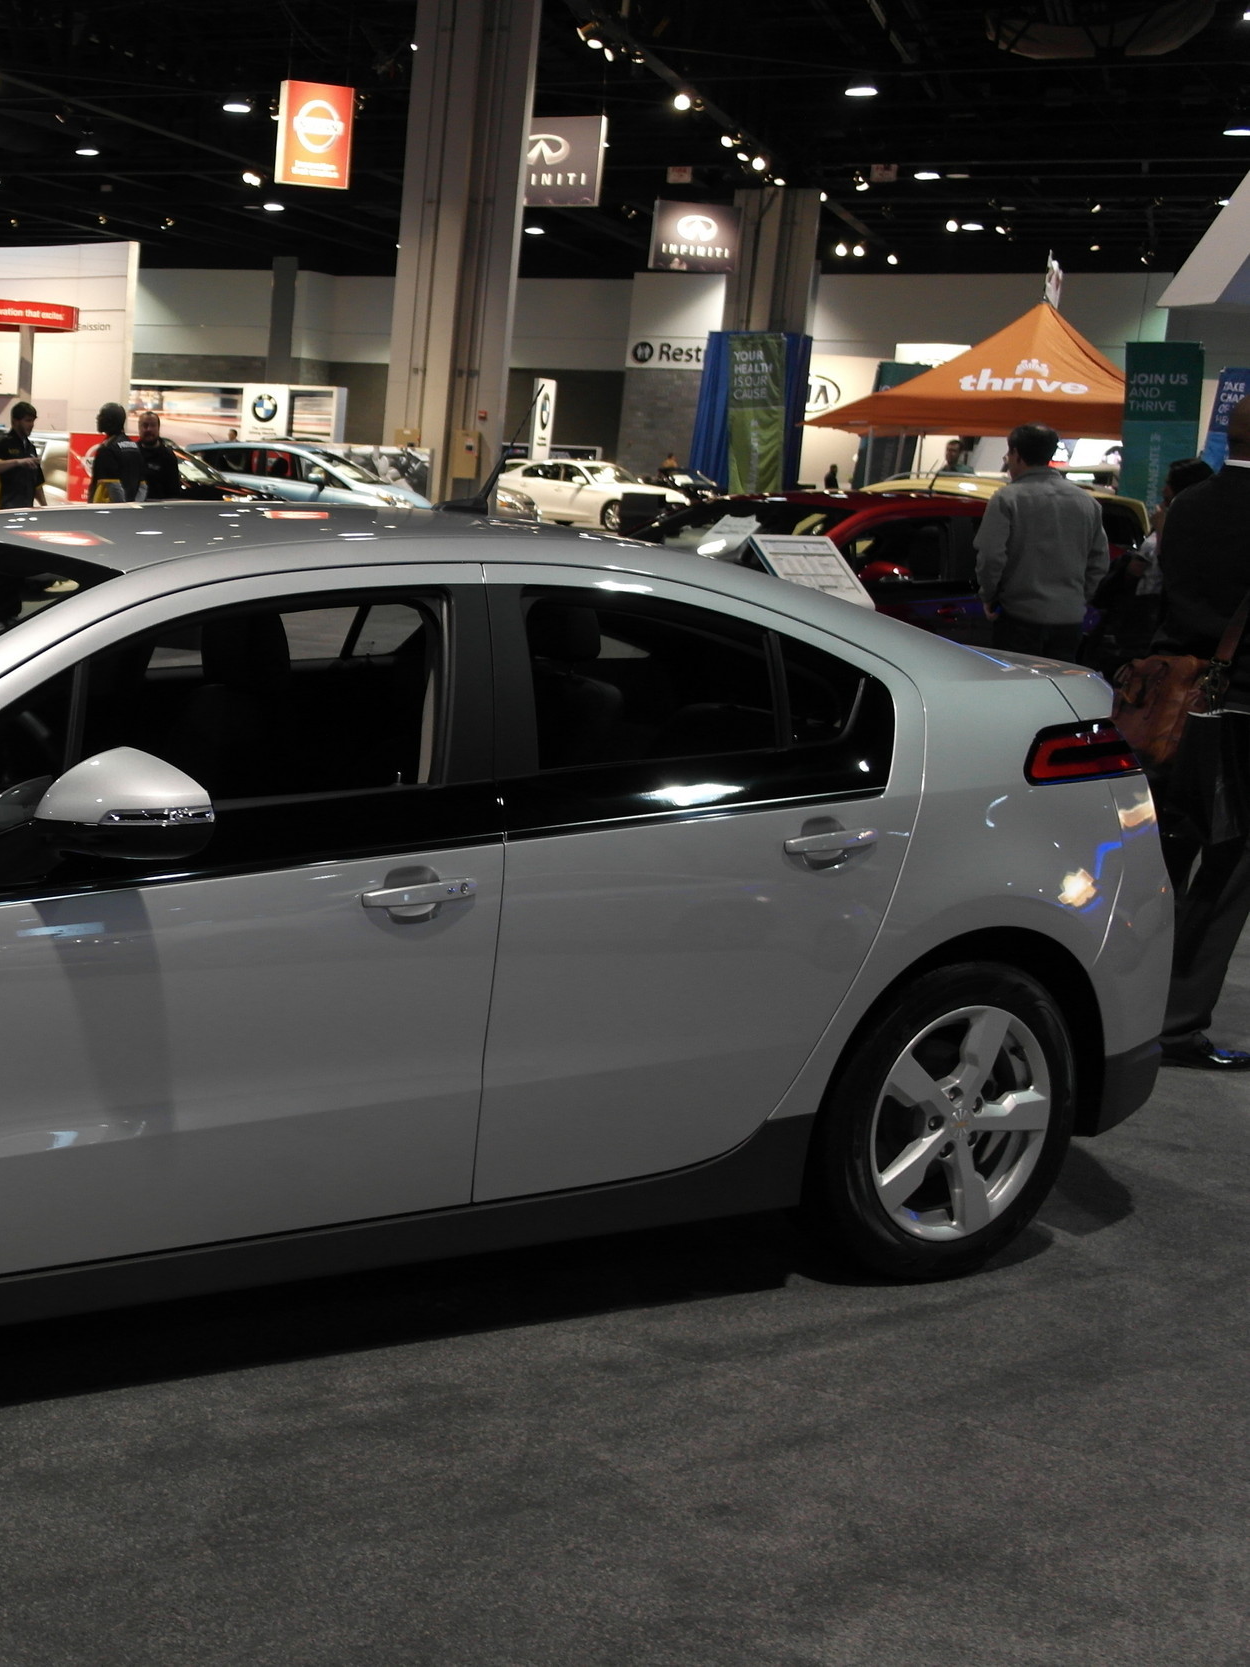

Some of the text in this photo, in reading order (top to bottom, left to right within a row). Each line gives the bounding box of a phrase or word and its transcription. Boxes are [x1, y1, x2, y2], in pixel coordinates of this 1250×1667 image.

[530, 172, 587, 186] INITI
[661, 243, 730, 259] INFINITI
[25, 308, 41, 318] that
[658, 342, 702, 362] Rest
[733, 350, 765, 362] YOUR
[734, 363, 773, 375] HEALTH
[734, 375, 768, 388] IS OUR
[959, 368, 1088, 395] thrive
[1129, 372, 1189, 385] JOIN US
[1222, 381, 1246, 392] TAKE
[733, 388, 768, 400] CAUSE
[1129, 387, 1160, 399] AND
[1128, 400, 1177, 412] THRIVE
